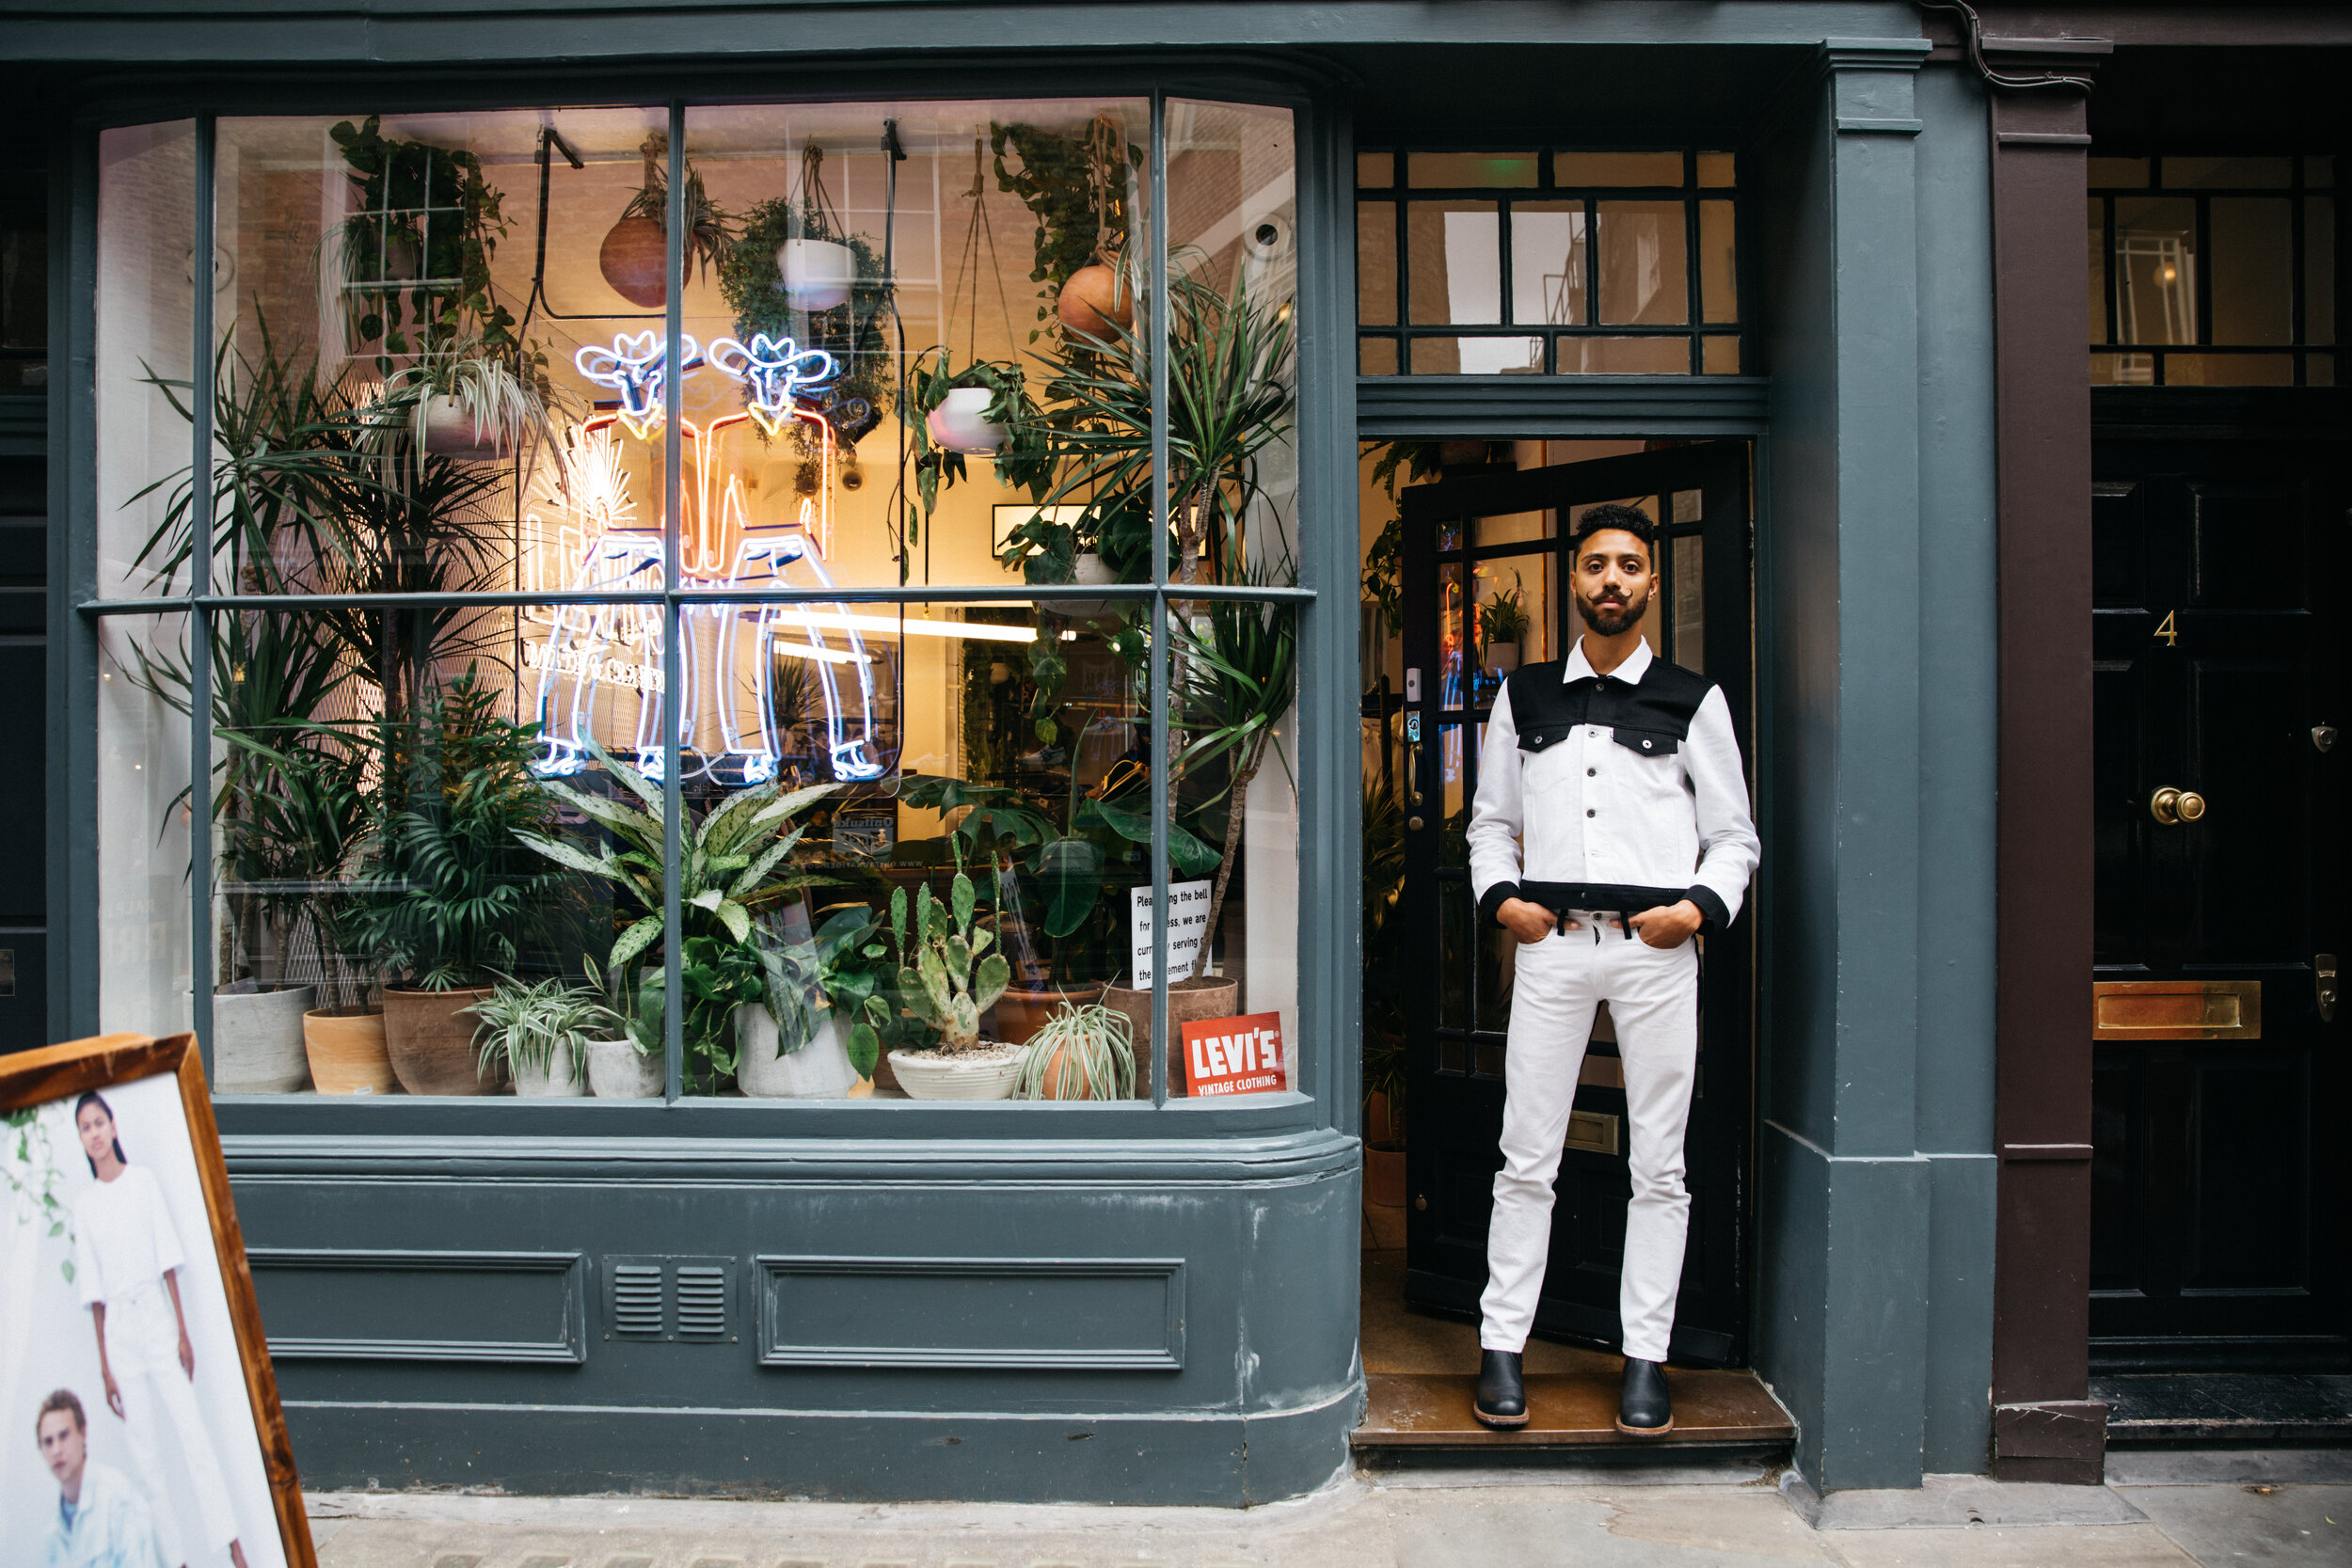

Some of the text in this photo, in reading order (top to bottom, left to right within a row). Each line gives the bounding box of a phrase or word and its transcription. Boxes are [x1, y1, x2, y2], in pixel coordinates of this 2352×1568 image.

[2153, 610, 2178, 647] 4
[1136, 888, 1208, 908] Plea ng the bell
[1139, 921, 1151, 932] for
[1183, 915, 1193, 926] we
[1195, 914, 1206, 924] are
[1172, 937, 1198, 950] serving
[1139, 970, 1152, 981] the
[1198, 1075, 1278, 1097] VINTAGE CLOTHING
